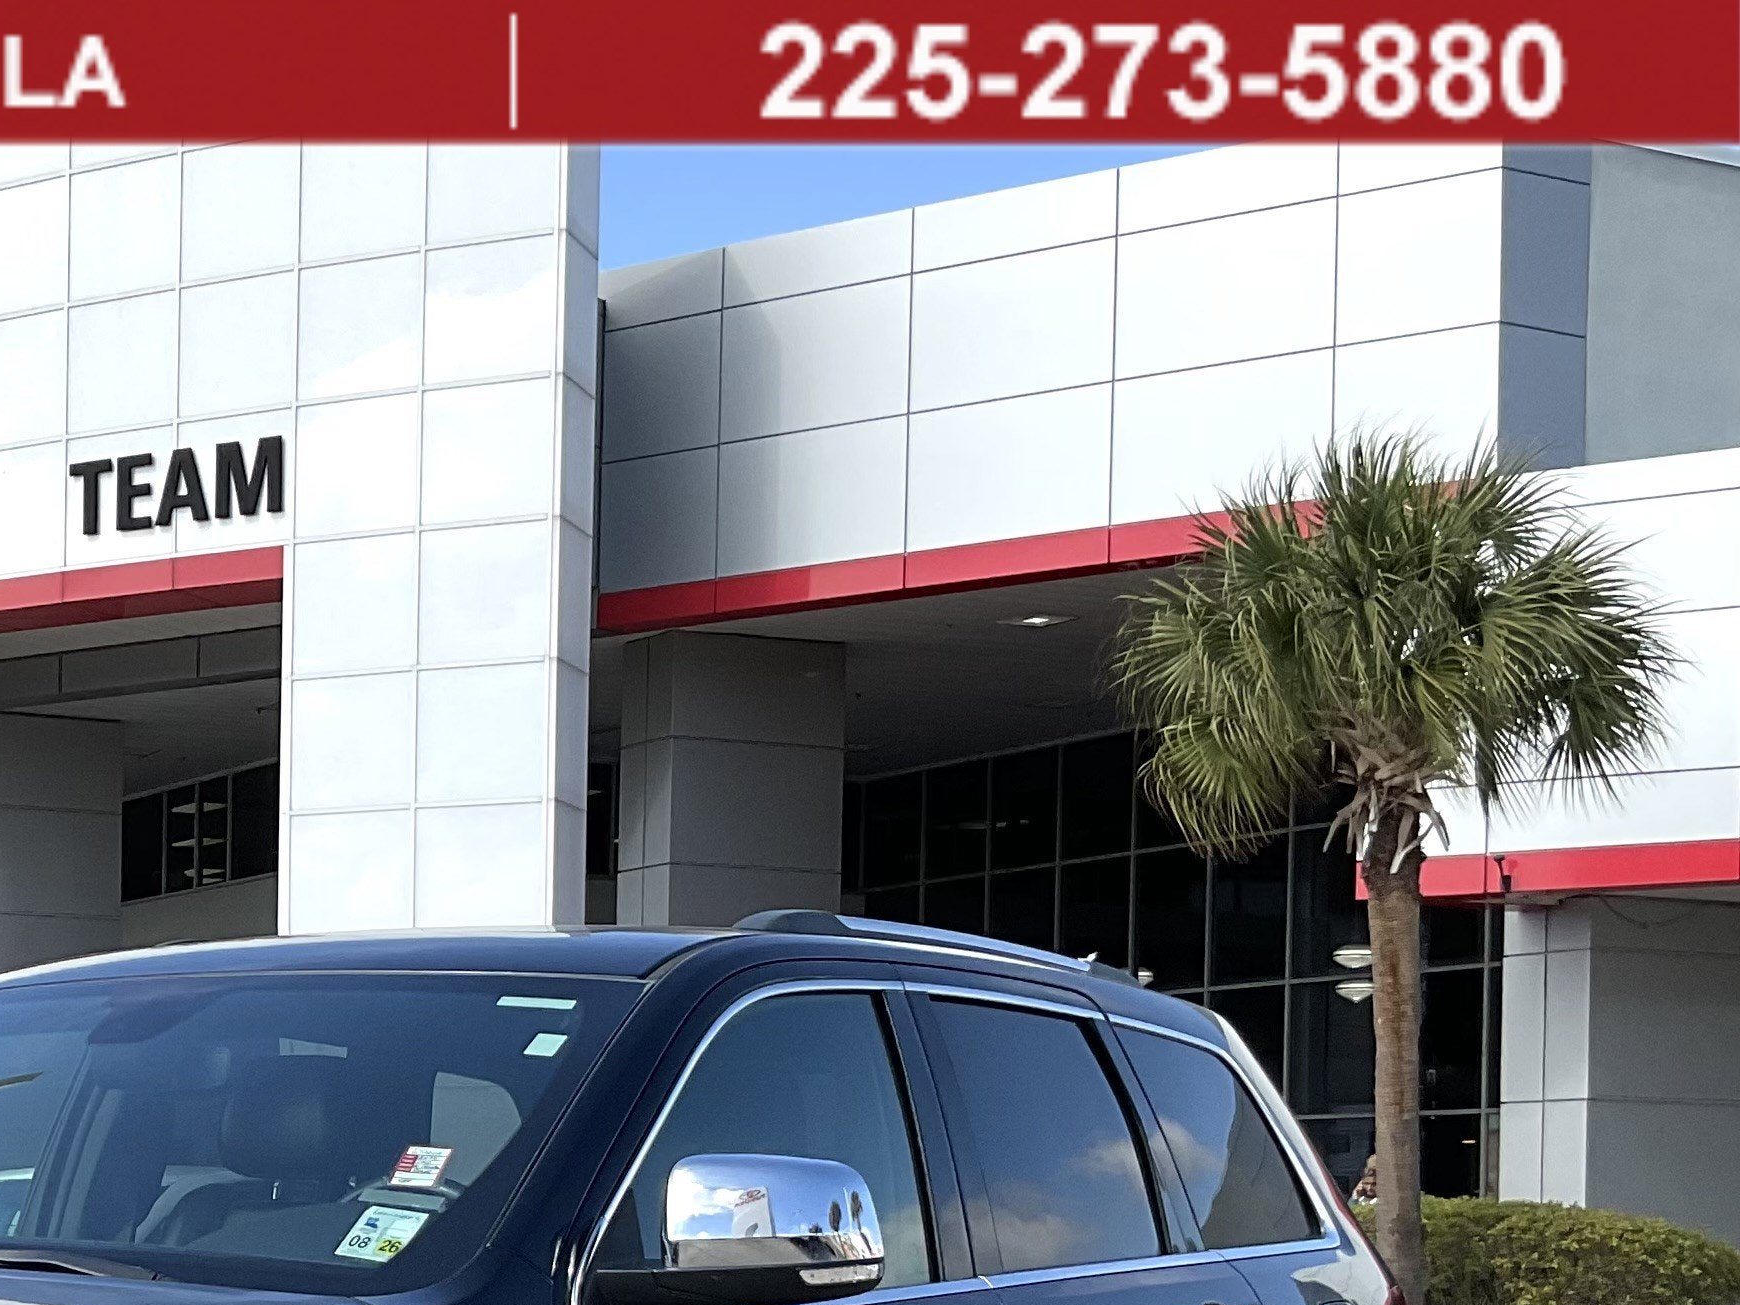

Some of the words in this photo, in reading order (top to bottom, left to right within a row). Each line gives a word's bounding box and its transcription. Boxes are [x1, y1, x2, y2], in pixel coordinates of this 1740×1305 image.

[68, 434, 285, 535] TEAM
[348, 1235, 371, 1249] 08
[377, 1239, 403, 1253] 26
